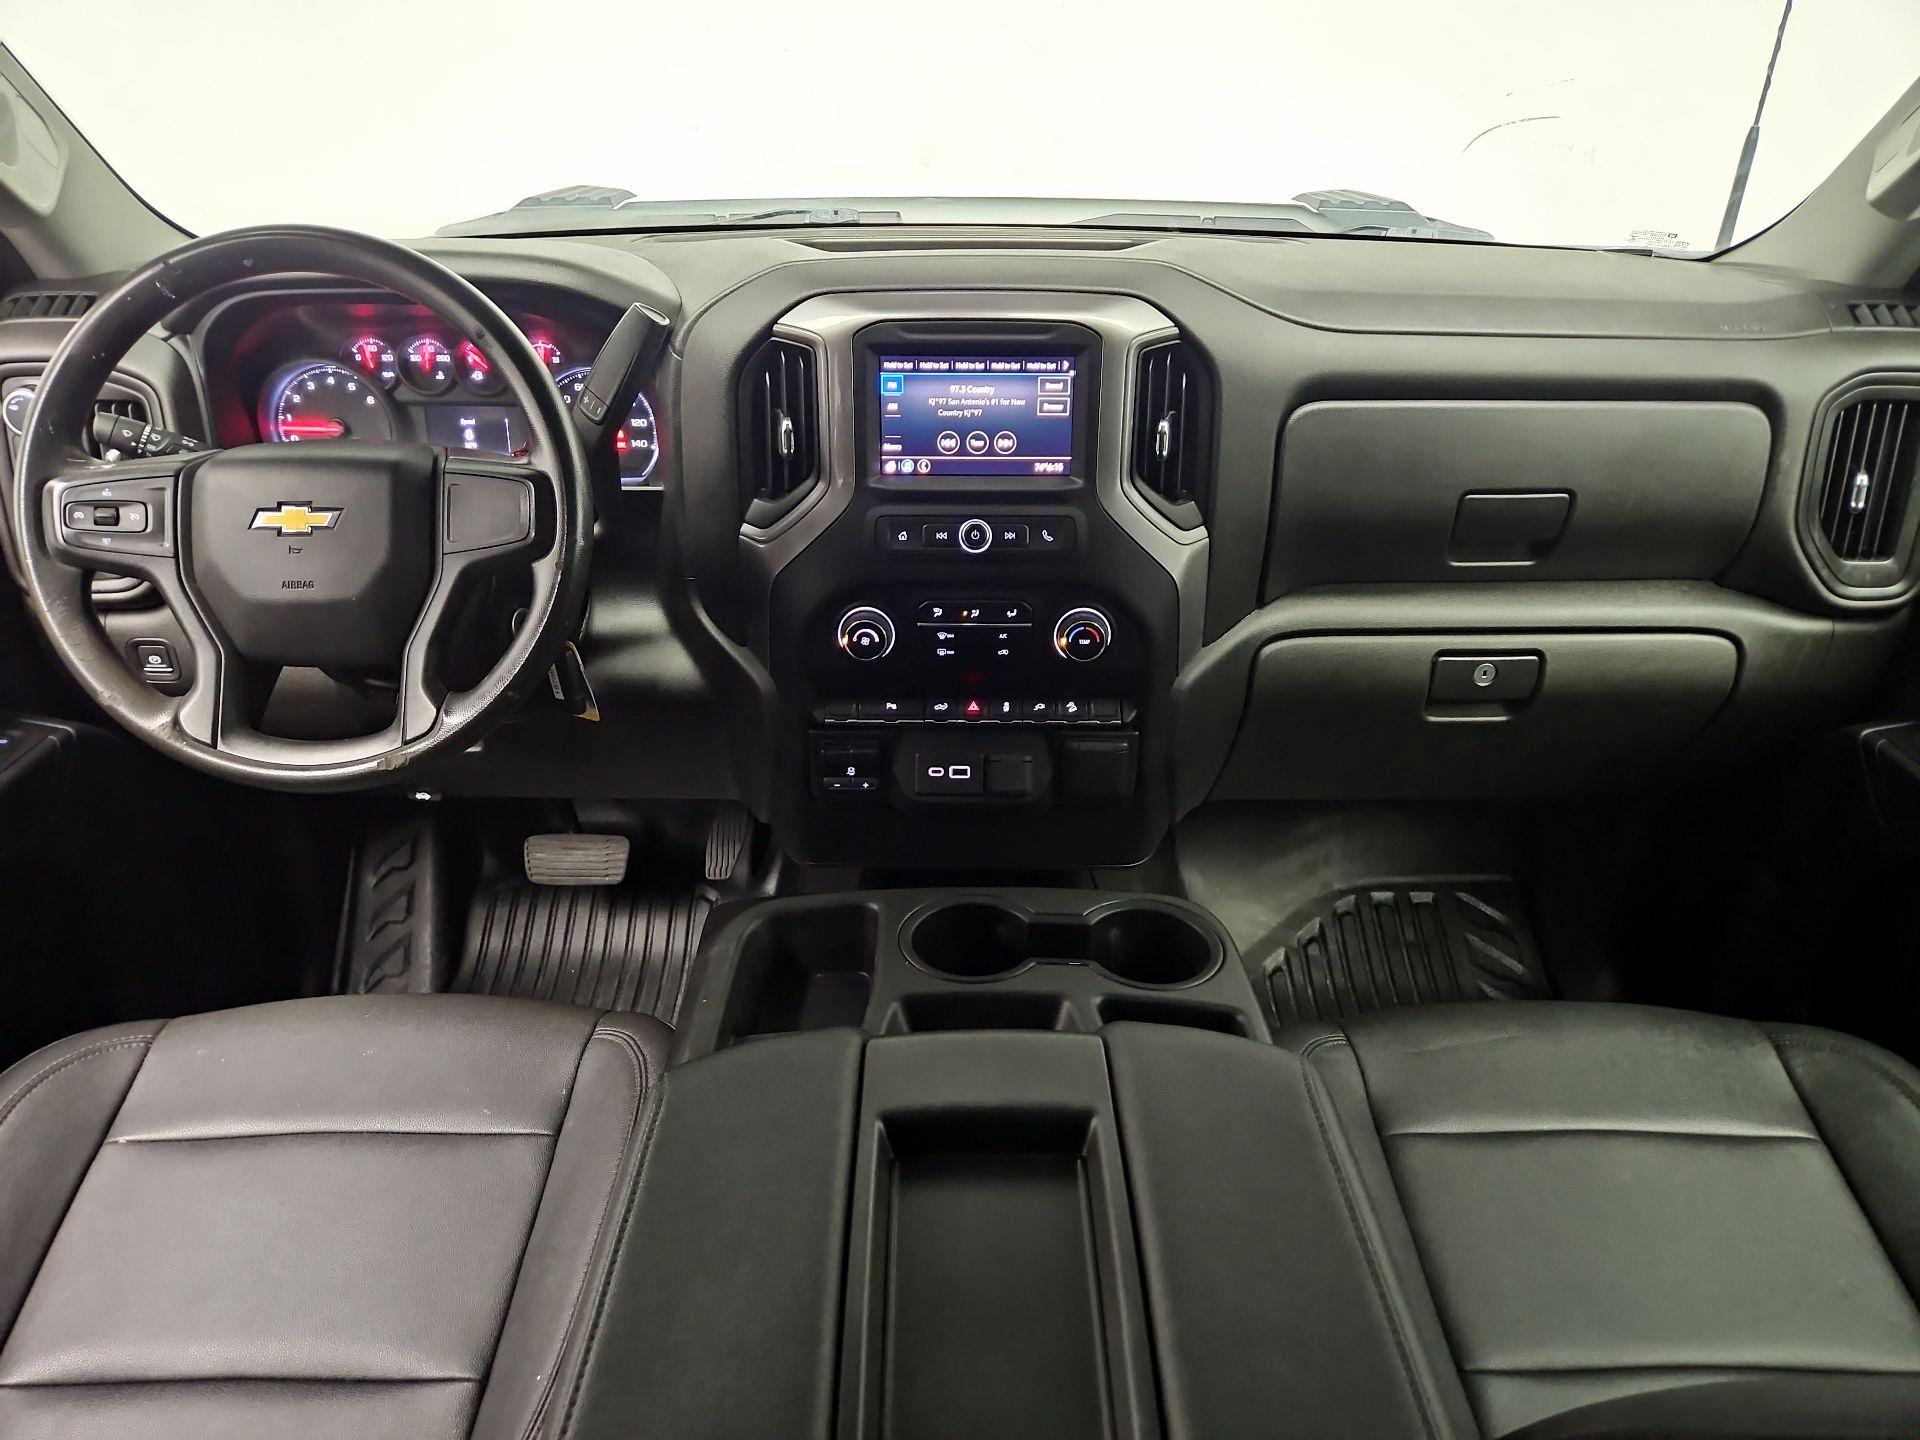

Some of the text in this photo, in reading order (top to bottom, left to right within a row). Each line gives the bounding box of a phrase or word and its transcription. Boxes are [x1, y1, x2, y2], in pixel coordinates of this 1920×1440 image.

[327, 376, 335, 385] 4
[307, 382, 315, 390] 3
[348, 382, 356, 391] 5
[967, 385, 995, 395] Country
[293, 395, 301, 403] 2
[366, 396, 375, 404] 6
[961, 397, 990, 406] Antonio's
[938, 409, 962, 418] Country
[631, 418, 647, 427] 120
[282, 581, 314, 589] AIRBAG
